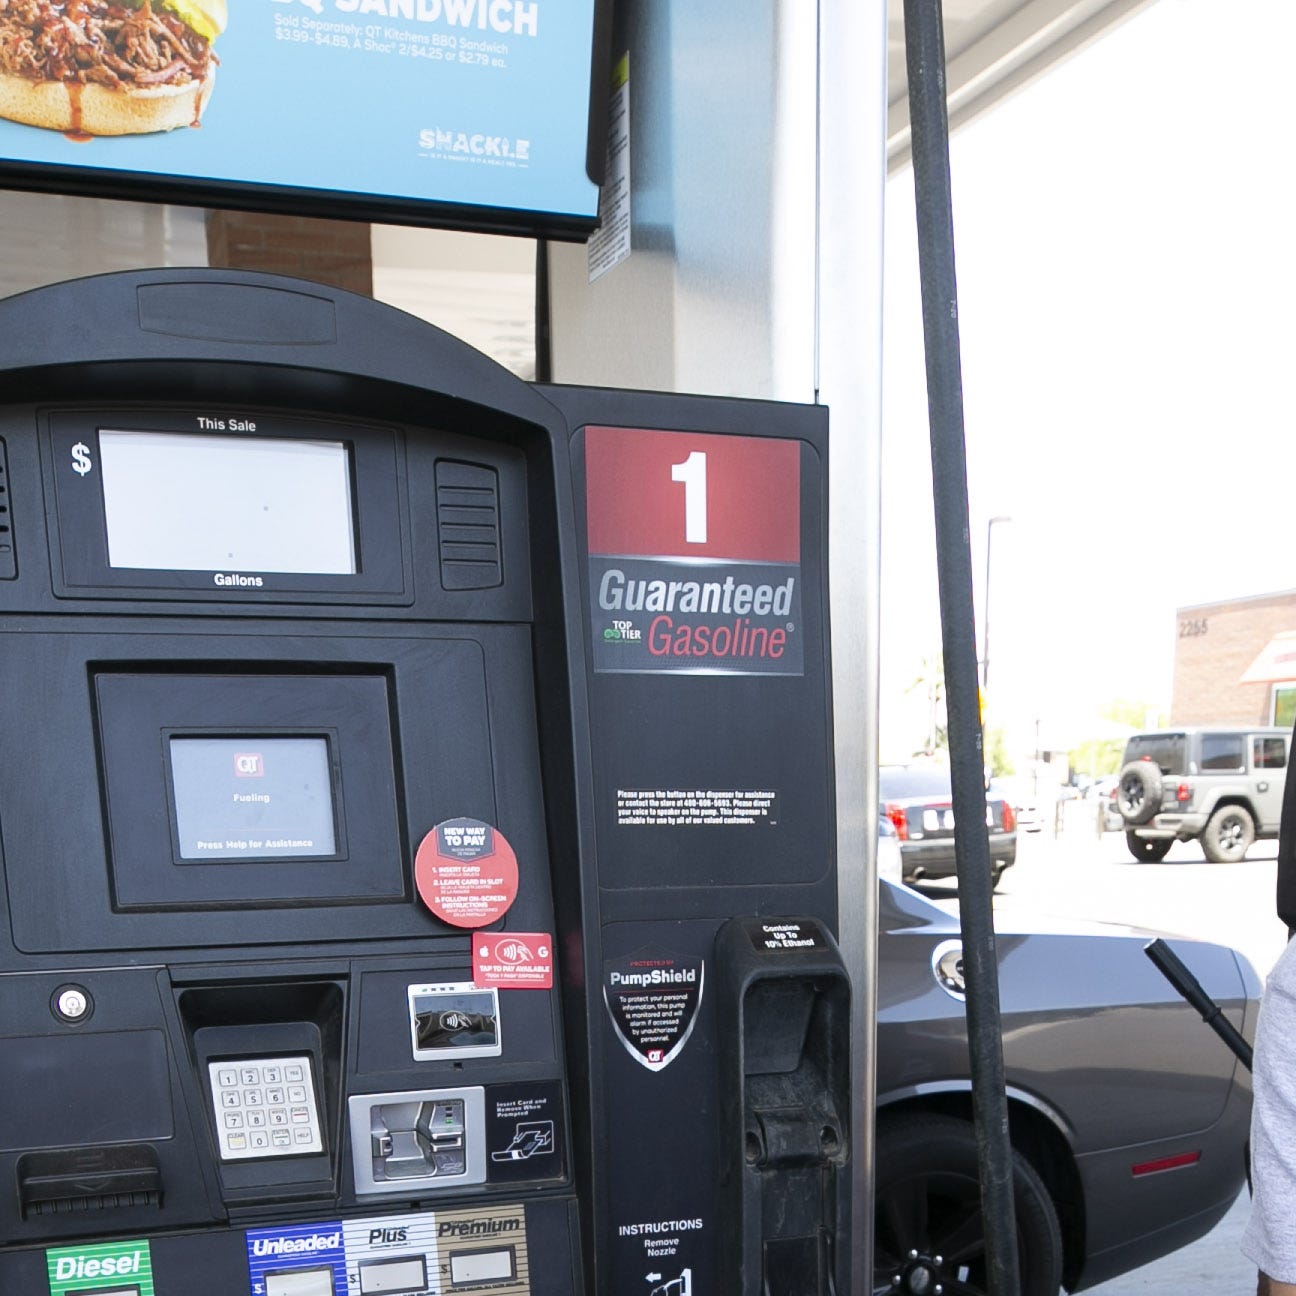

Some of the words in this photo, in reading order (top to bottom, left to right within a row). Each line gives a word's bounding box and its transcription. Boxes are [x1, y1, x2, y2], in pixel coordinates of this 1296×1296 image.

[274, 13, 301, 28] Sold
[302, 18, 364, 36] Separately:
[365, 25, 384, 38] QT
[384, 27, 430, 45] Kitchens
[432, 34, 457, 49] BBQ
[459, 38, 508, 55] Sandwich
[197, 417, 226, 432] This
[229, 418, 256, 432] Sale
[71, 442, 92, 476] $
[671, 451, 707, 543] 1
[214, 572, 263, 588] Gallons
[598, 569, 795, 616] Guaranteed
[613, 621, 632, 630] TOP
[622, 629, 641, 640] TIER
[237, 756, 258, 773] QT
[234, 794, 270, 803] Fueling
[197, 841, 222, 849] Press
[226, 840, 247, 849] Help
[249, 840, 262, 848] for
[265, 839, 313, 848] Assistance
[445, 836, 462, 846] TO
[464, 836, 486, 846] PAY
[765, 940, 782, 948] 10%
[782, 939, 815, 947] Ethanol
[611, 969, 696, 987] PumpShield
[664, 994, 688, 1002] personal
[438, 1218, 520, 1238] Premium
[619, 1218, 703, 1236] INSTRUCTIONS
[253, 1232, 341, 1256] Unleaded
[368, 1227, 408, 1245] Plus
[644, 1237, 679, 1248] Remove
[647, 1247, 677, 1257] Nozzle
[56, 1251, 140, 1280] Diesel
